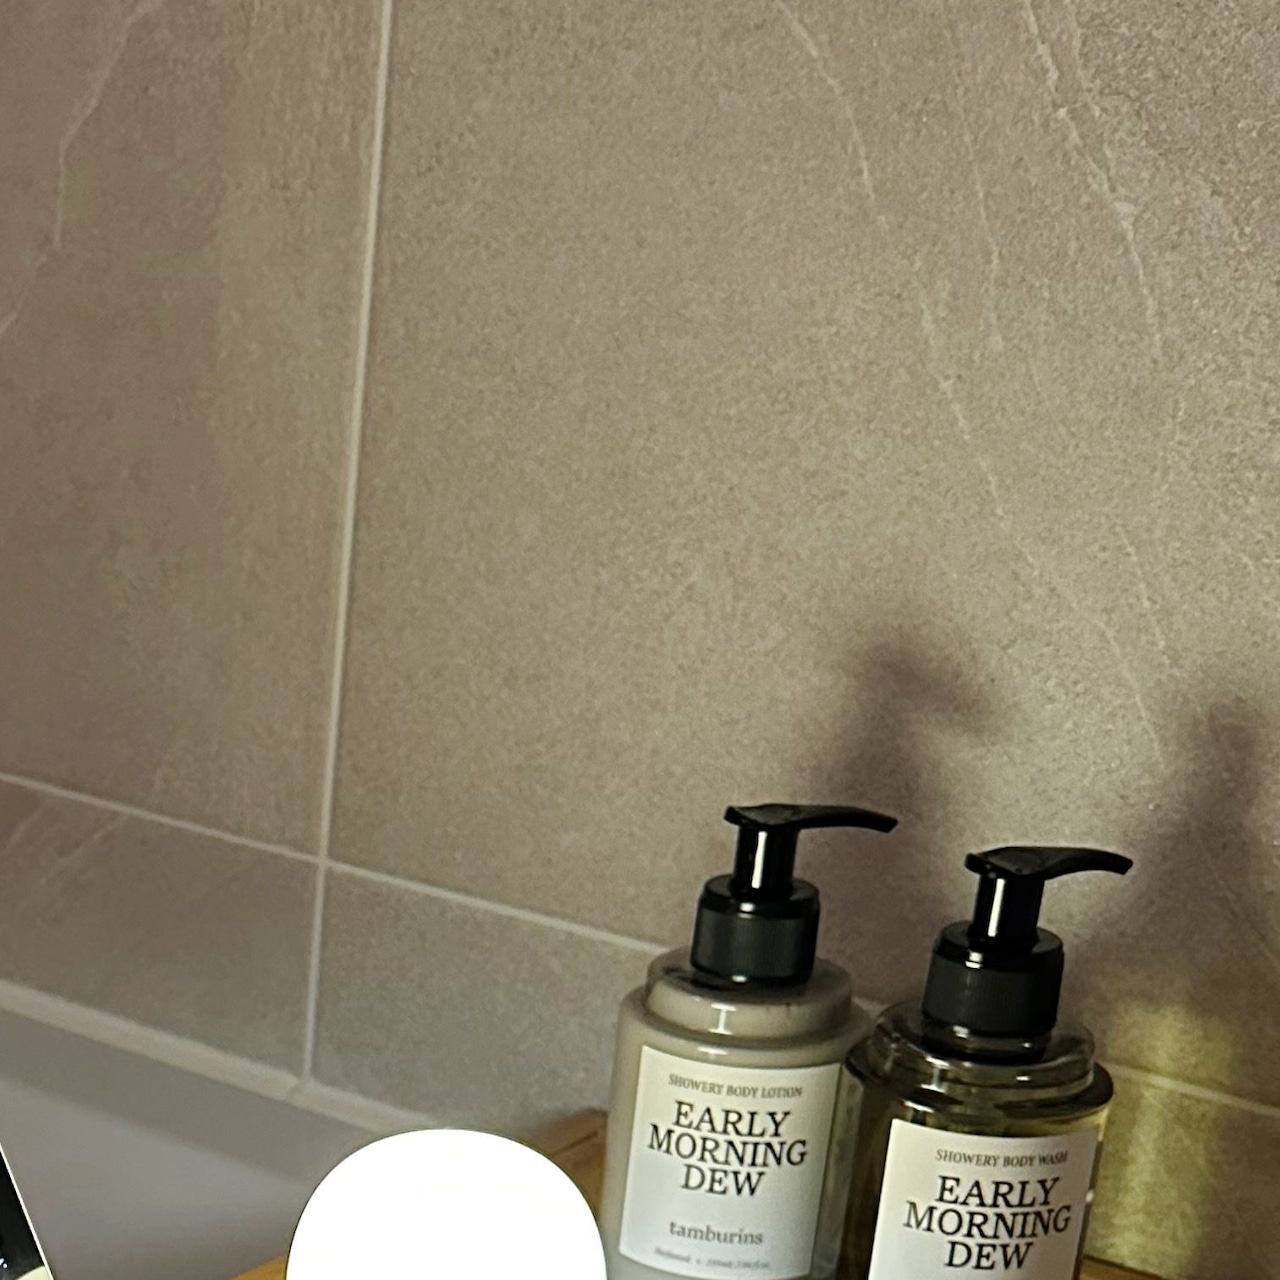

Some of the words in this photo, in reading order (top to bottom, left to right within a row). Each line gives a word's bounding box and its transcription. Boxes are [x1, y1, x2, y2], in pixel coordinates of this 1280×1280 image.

[668, 1073, 723, 1096] SHOWERY
[726, 1085, 759, 1098] BODY
[761, 1086, 803, 1099] LOTION
[672, 1100, 791, 1138] EARLY
[647, 1122, 808, 1168] MORNING
[936, 1148, 1000, 1168] SHOWERY
[1003, 1153, 1035, 1168] BODY
[1038, 1150, 1069, 1166] WASH
[681, 1163, 765, 1197] DEW
[935, 1175, 1060, 1209] EARLY
[669, 1220, 764, 1246] tamburins
[902, 1200, 1071, 1240] MORNING
[944, 1240, 1034, 1271] DEW
